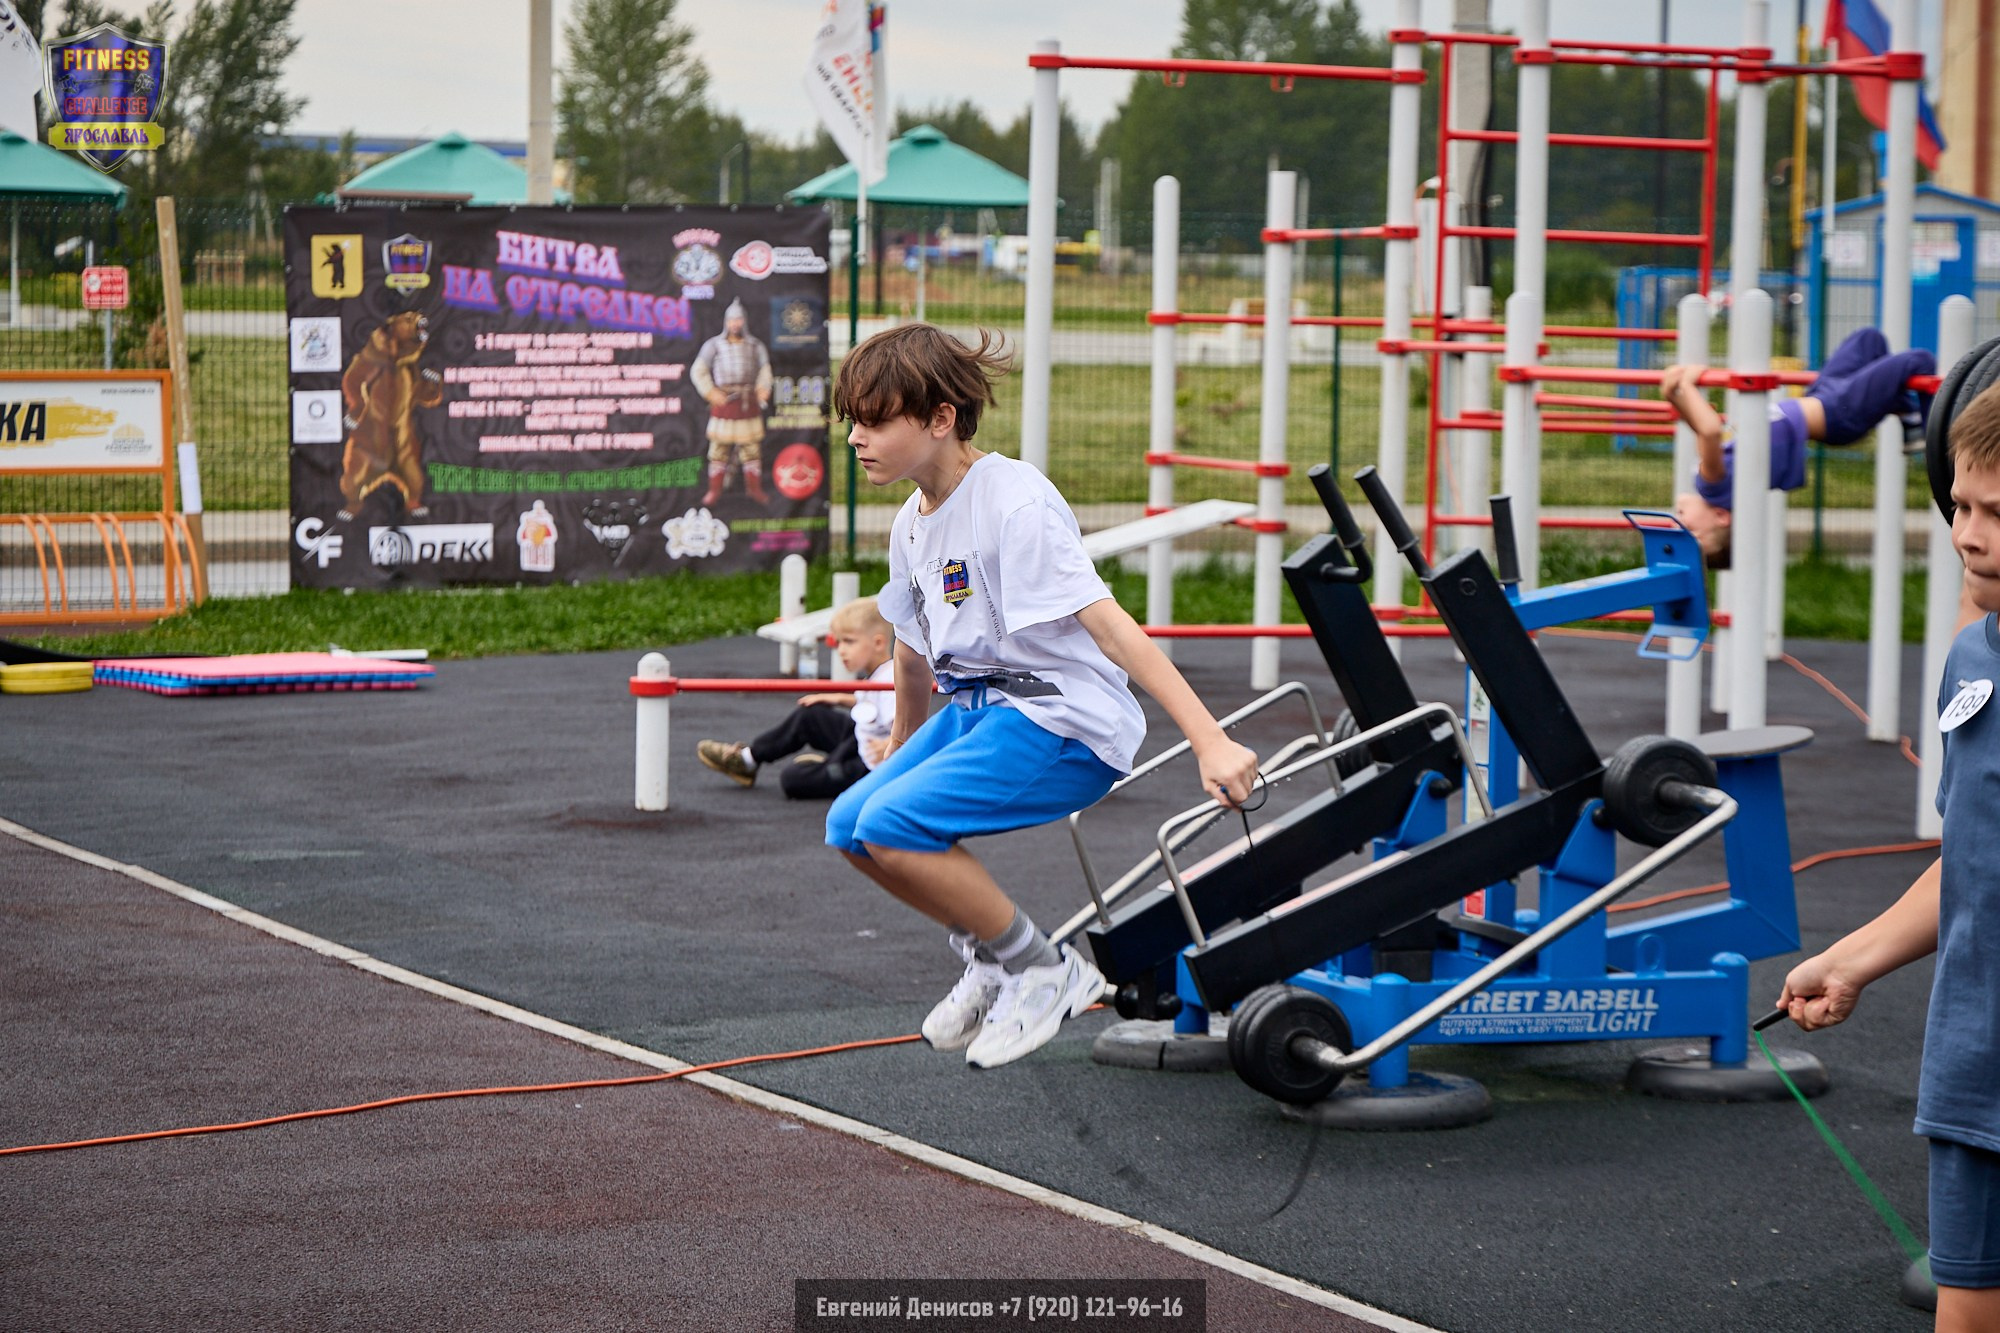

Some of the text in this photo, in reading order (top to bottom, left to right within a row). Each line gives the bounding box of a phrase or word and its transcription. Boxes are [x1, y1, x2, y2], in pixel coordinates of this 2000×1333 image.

[496, 230, 625, 284] БИТВА
[442, 264, 499, 308] НА
[1947, 694, 1986, 718] 199
[1449, 988, 1659, 1014] TREET BARBELL
[1586, 1011, 1656, 1033] LIGHT
